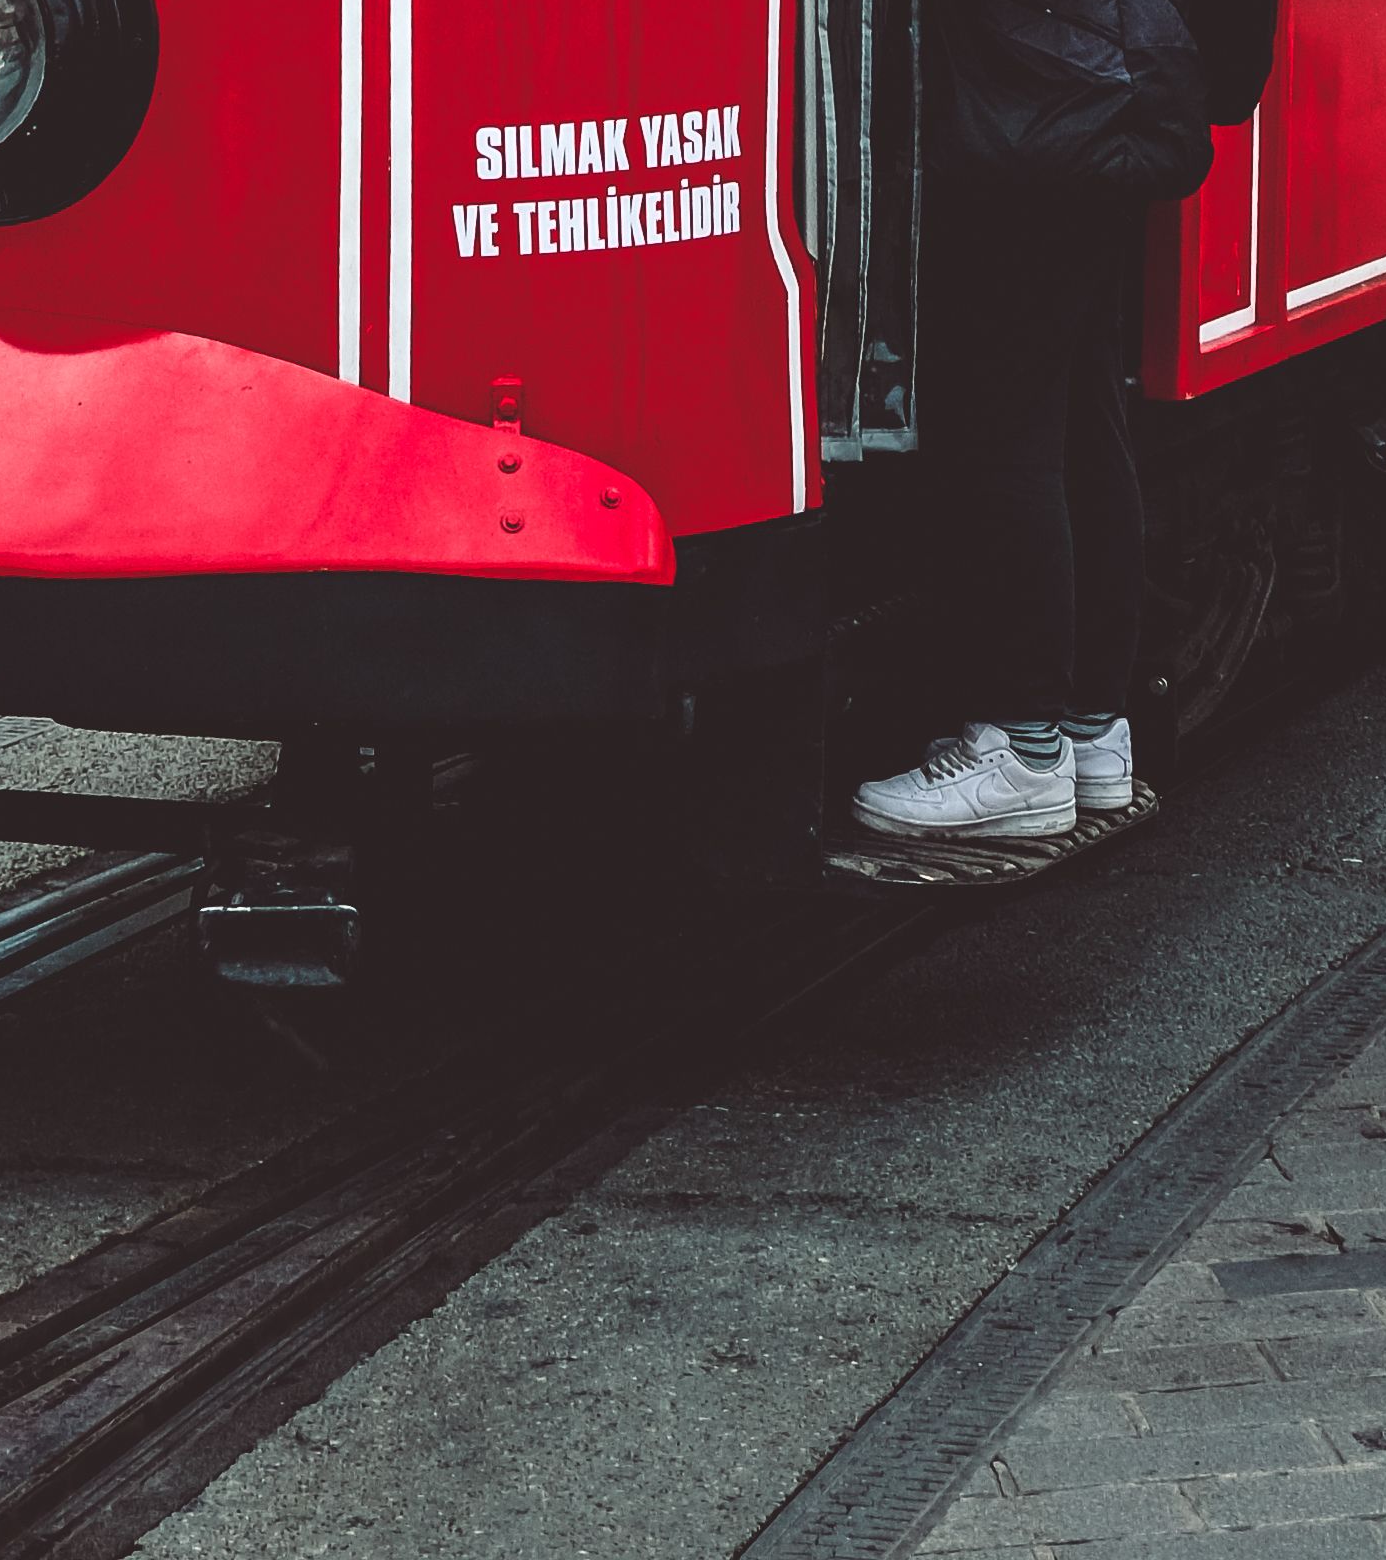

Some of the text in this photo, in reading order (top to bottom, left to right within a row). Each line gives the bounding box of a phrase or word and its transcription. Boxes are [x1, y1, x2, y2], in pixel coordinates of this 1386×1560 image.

[475, 105, 742, 180] SILMAK YASAK
[452, 174, 741, 258] VE TEHLİKELİDİR
